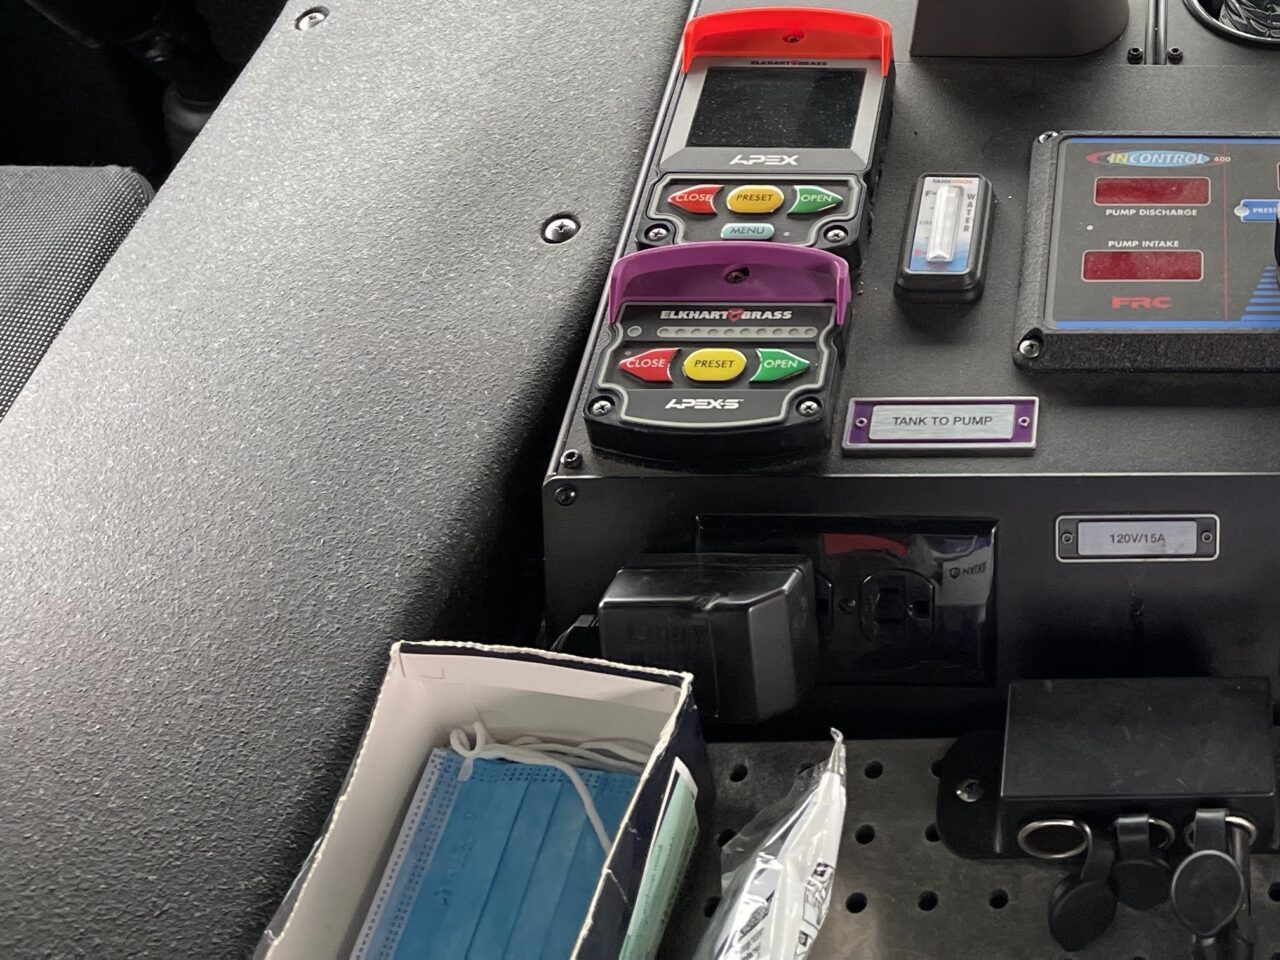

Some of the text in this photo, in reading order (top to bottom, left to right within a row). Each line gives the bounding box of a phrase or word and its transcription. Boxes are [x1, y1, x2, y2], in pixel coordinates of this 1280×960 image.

[676, 194, 712, 202] CLOSE
[736, 194, 774, 202] PRESET
[801, 194, 832, 202] OPEN
[963, 193, 976, 232] WATER
[1106, 208, 1198, 216] PUMP DISCHARGE
[730, 226, 765, 235] MENU
[1142, 240, 1180, 248] INTAKE
[1112, 296, 1173, 309] FRC
[660, 310, 792, 320] ELKHART BRASS
[626, 359, 666, 368] CLOSE
[694, 360, 735, 368] PRESET
[764, 360, 799, 368] OPEN
[893, 416, 993, 426] TANK TO PUMP
[1110, 533, 1166, 544] 120V/15A
